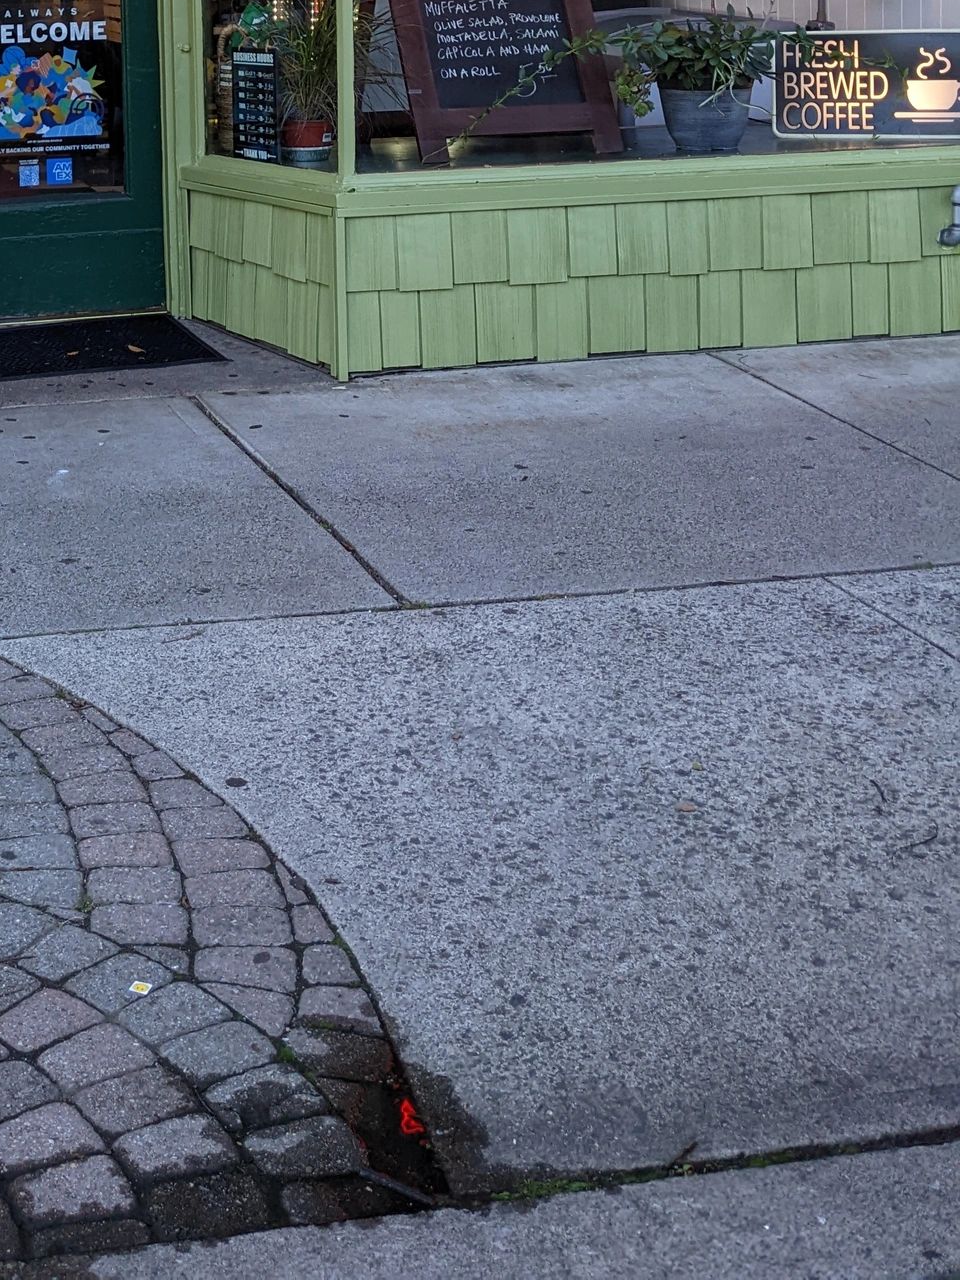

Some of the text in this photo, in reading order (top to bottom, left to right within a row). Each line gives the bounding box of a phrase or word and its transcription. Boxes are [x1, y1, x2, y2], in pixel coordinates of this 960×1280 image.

[4, 7, 78, 18] ALWAYS
[233, 51, 257, 62] BUSINESS
[499, 44, 520, 57] AND
[523, 43, 551, 57] HAM
[440, 69, 458, 79] ON
[460, 68, 470, 79] A
[470, 66, 502, 77] ROLL
[784, 71, 889, 100] BREWED
[783, 101, 875, 130] COFFEE
[80, 143, 111, 151] TOGETHER
